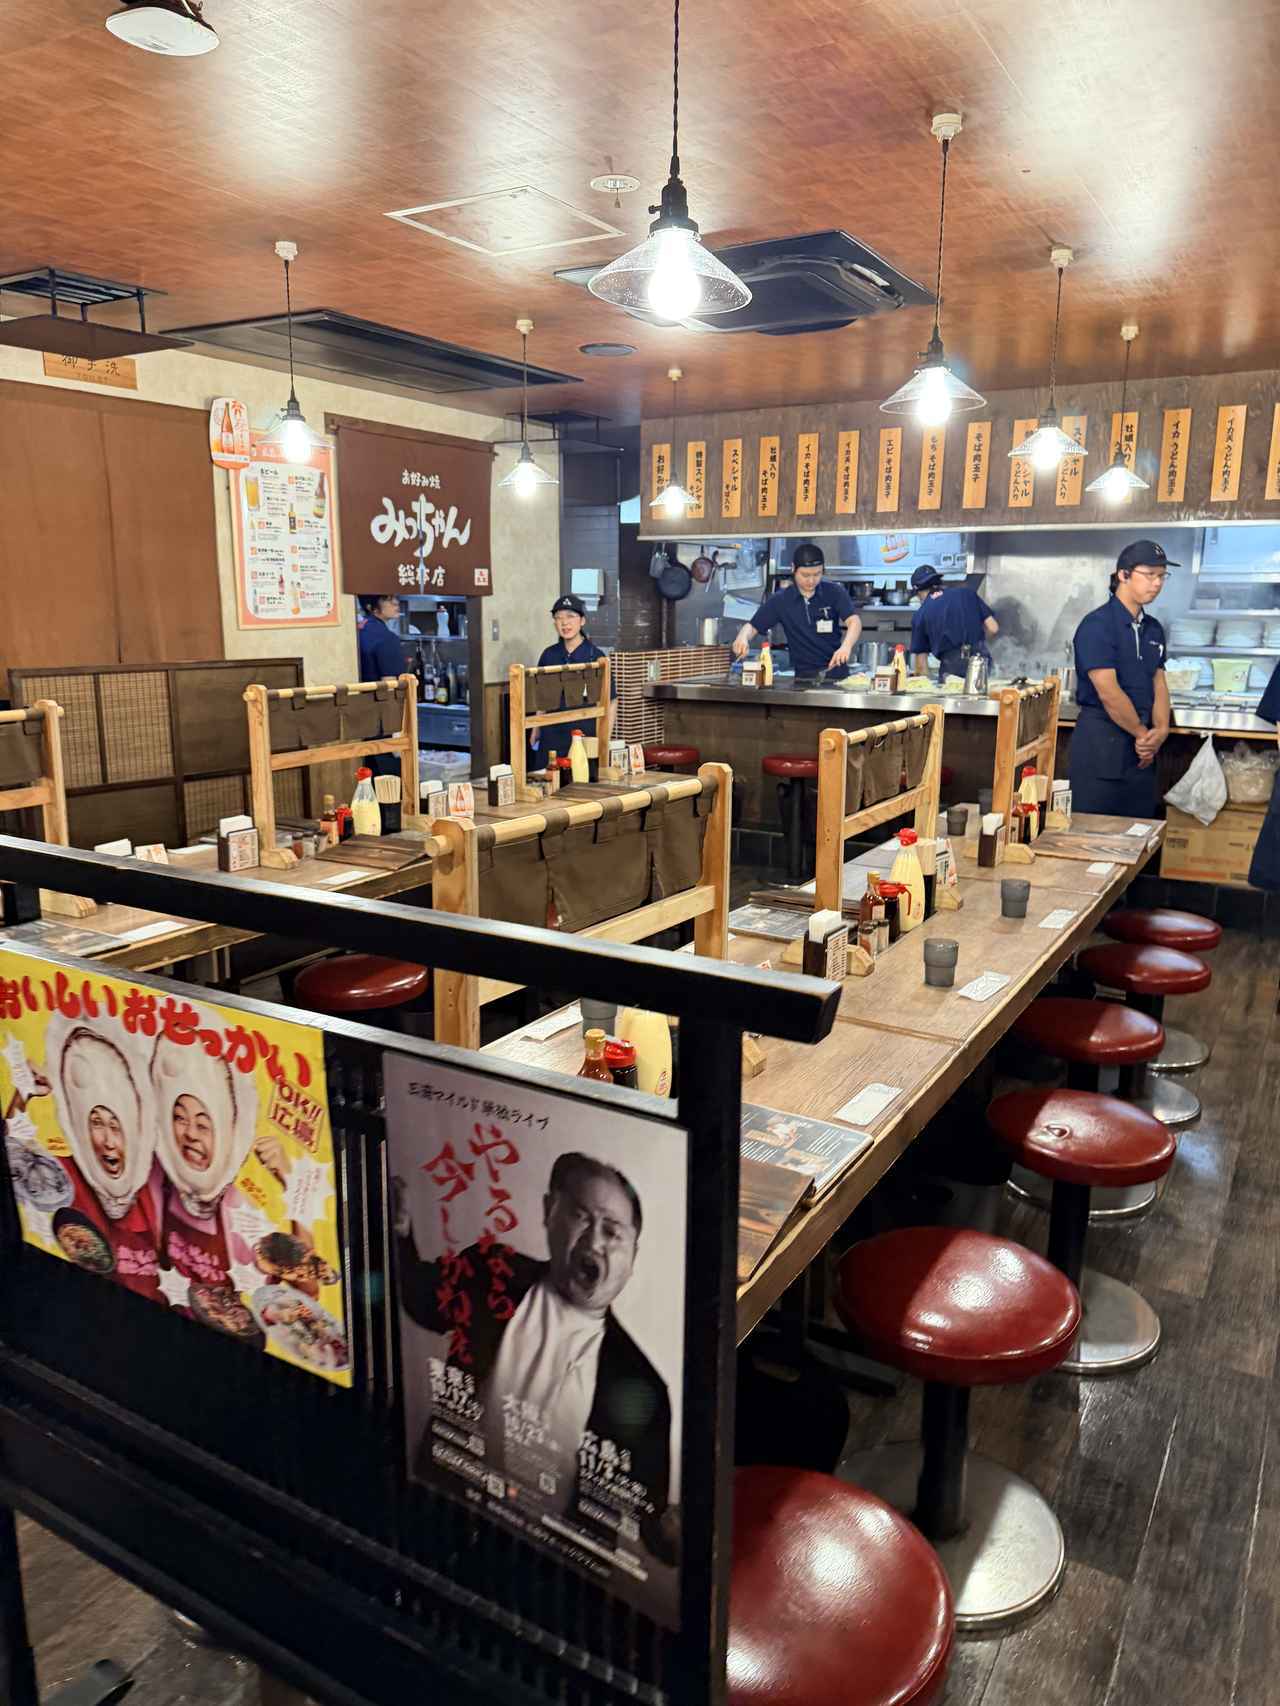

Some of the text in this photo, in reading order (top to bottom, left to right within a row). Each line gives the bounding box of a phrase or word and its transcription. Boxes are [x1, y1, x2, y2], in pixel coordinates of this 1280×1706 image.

[731, 449, 739, 491] スペシャル
[972, 433, 983, 483] そば肉玉子
[1012, 462, 1022, 502] うどん入り
[370, 493, 471, 558] みっちゃん
[397, 563, 446, 587] 総本店
